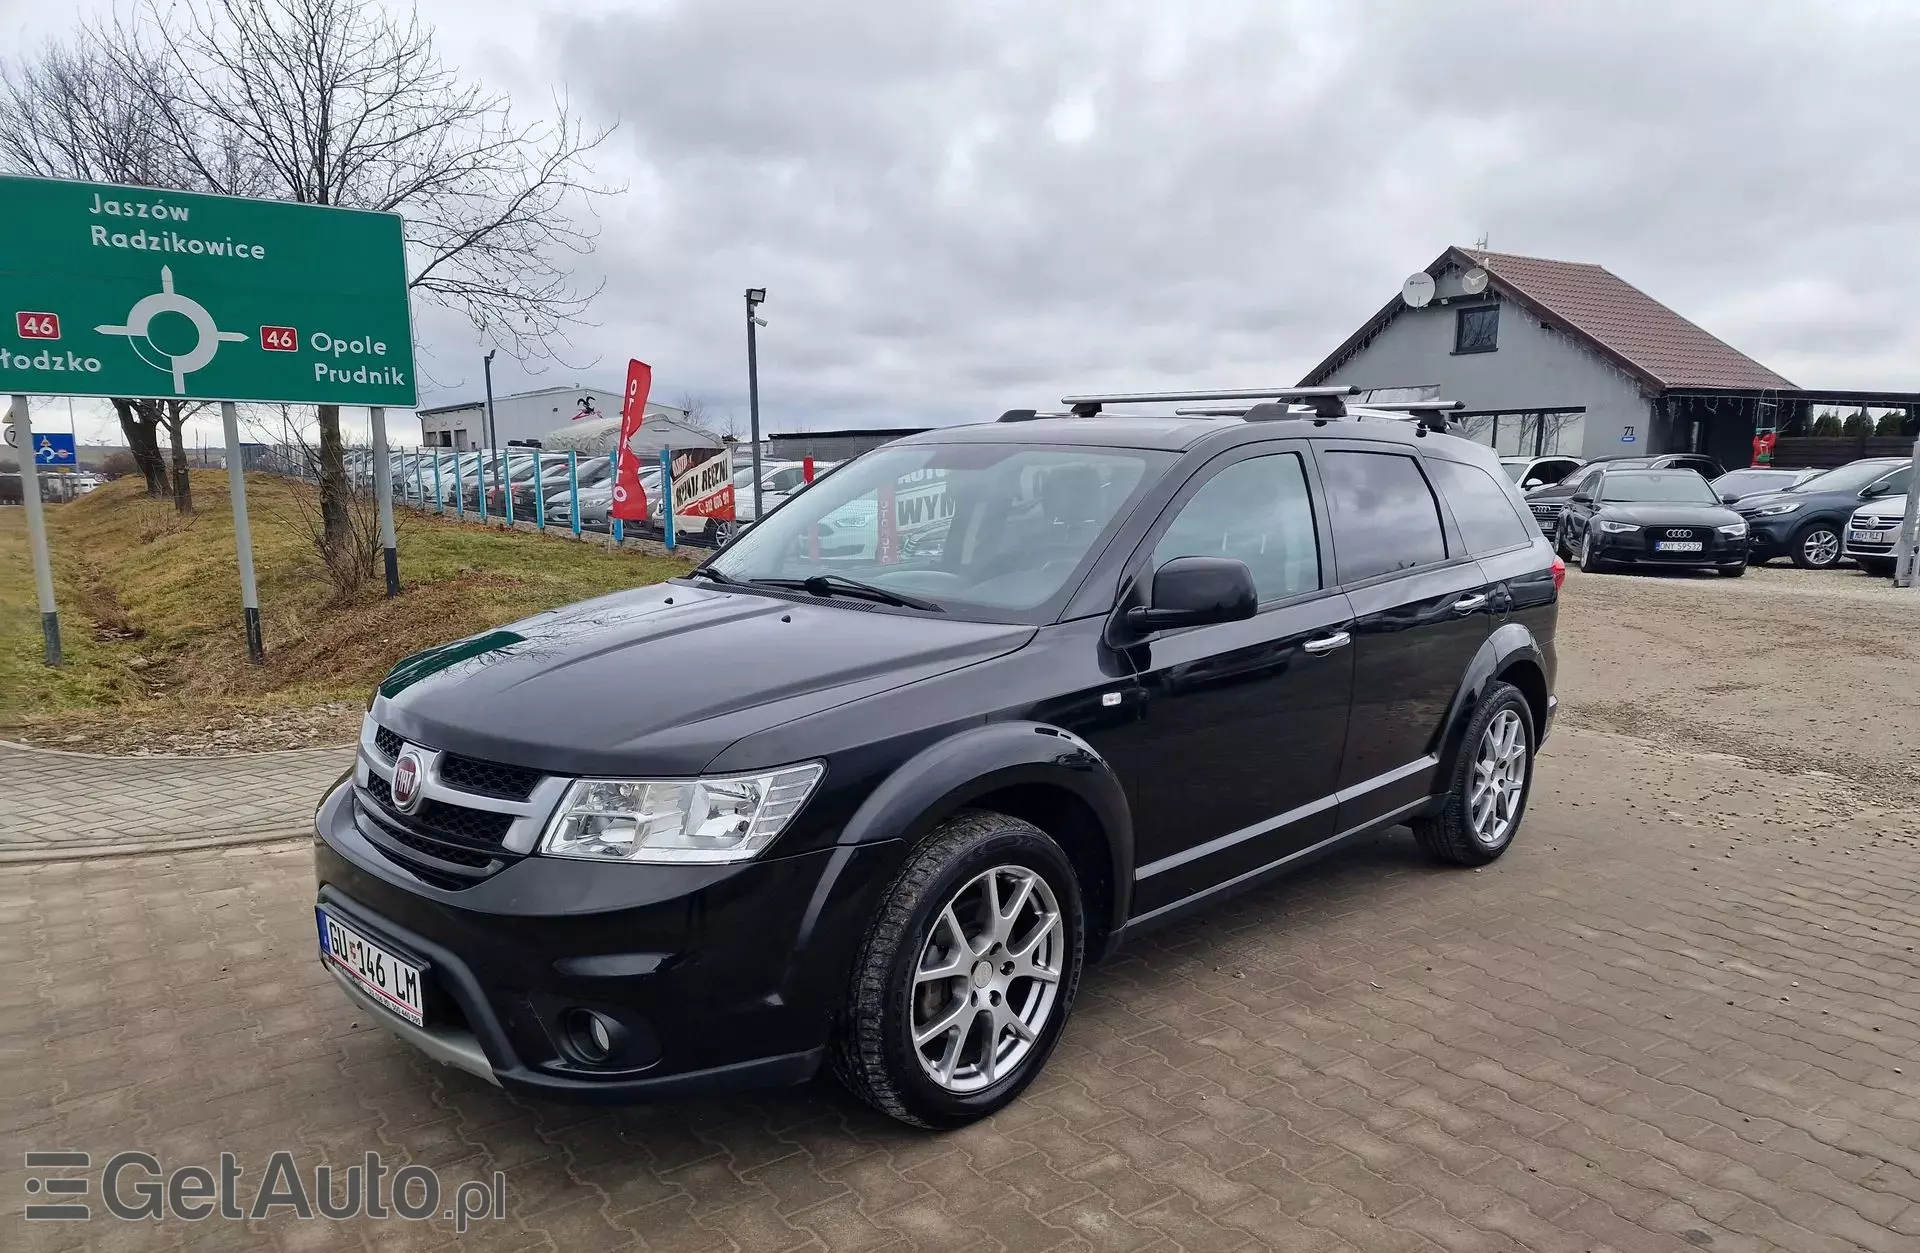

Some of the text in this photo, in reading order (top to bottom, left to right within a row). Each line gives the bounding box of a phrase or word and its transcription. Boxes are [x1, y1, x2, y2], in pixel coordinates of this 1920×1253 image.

[89, 193, 189, 221] Jaszów
[90, 225, 265, 259] Radzikowice
[24, 317, 53, 336] 46
[267, 331, 293, 347] 46
[311, 332, 387, 358] Opole
[0, 348, 101, 372] łodzko
[314, 363, 405, 386] Prudnik
[1624, 426, 1634, 436] 71
[1677, 542, 1701, 550] 59532
[396, 768, 414, 794] FIAT
[329, 921, 349, 962] GU
[357, 940, 386, 988] 146
[394, 961, 418, 1008] LM
